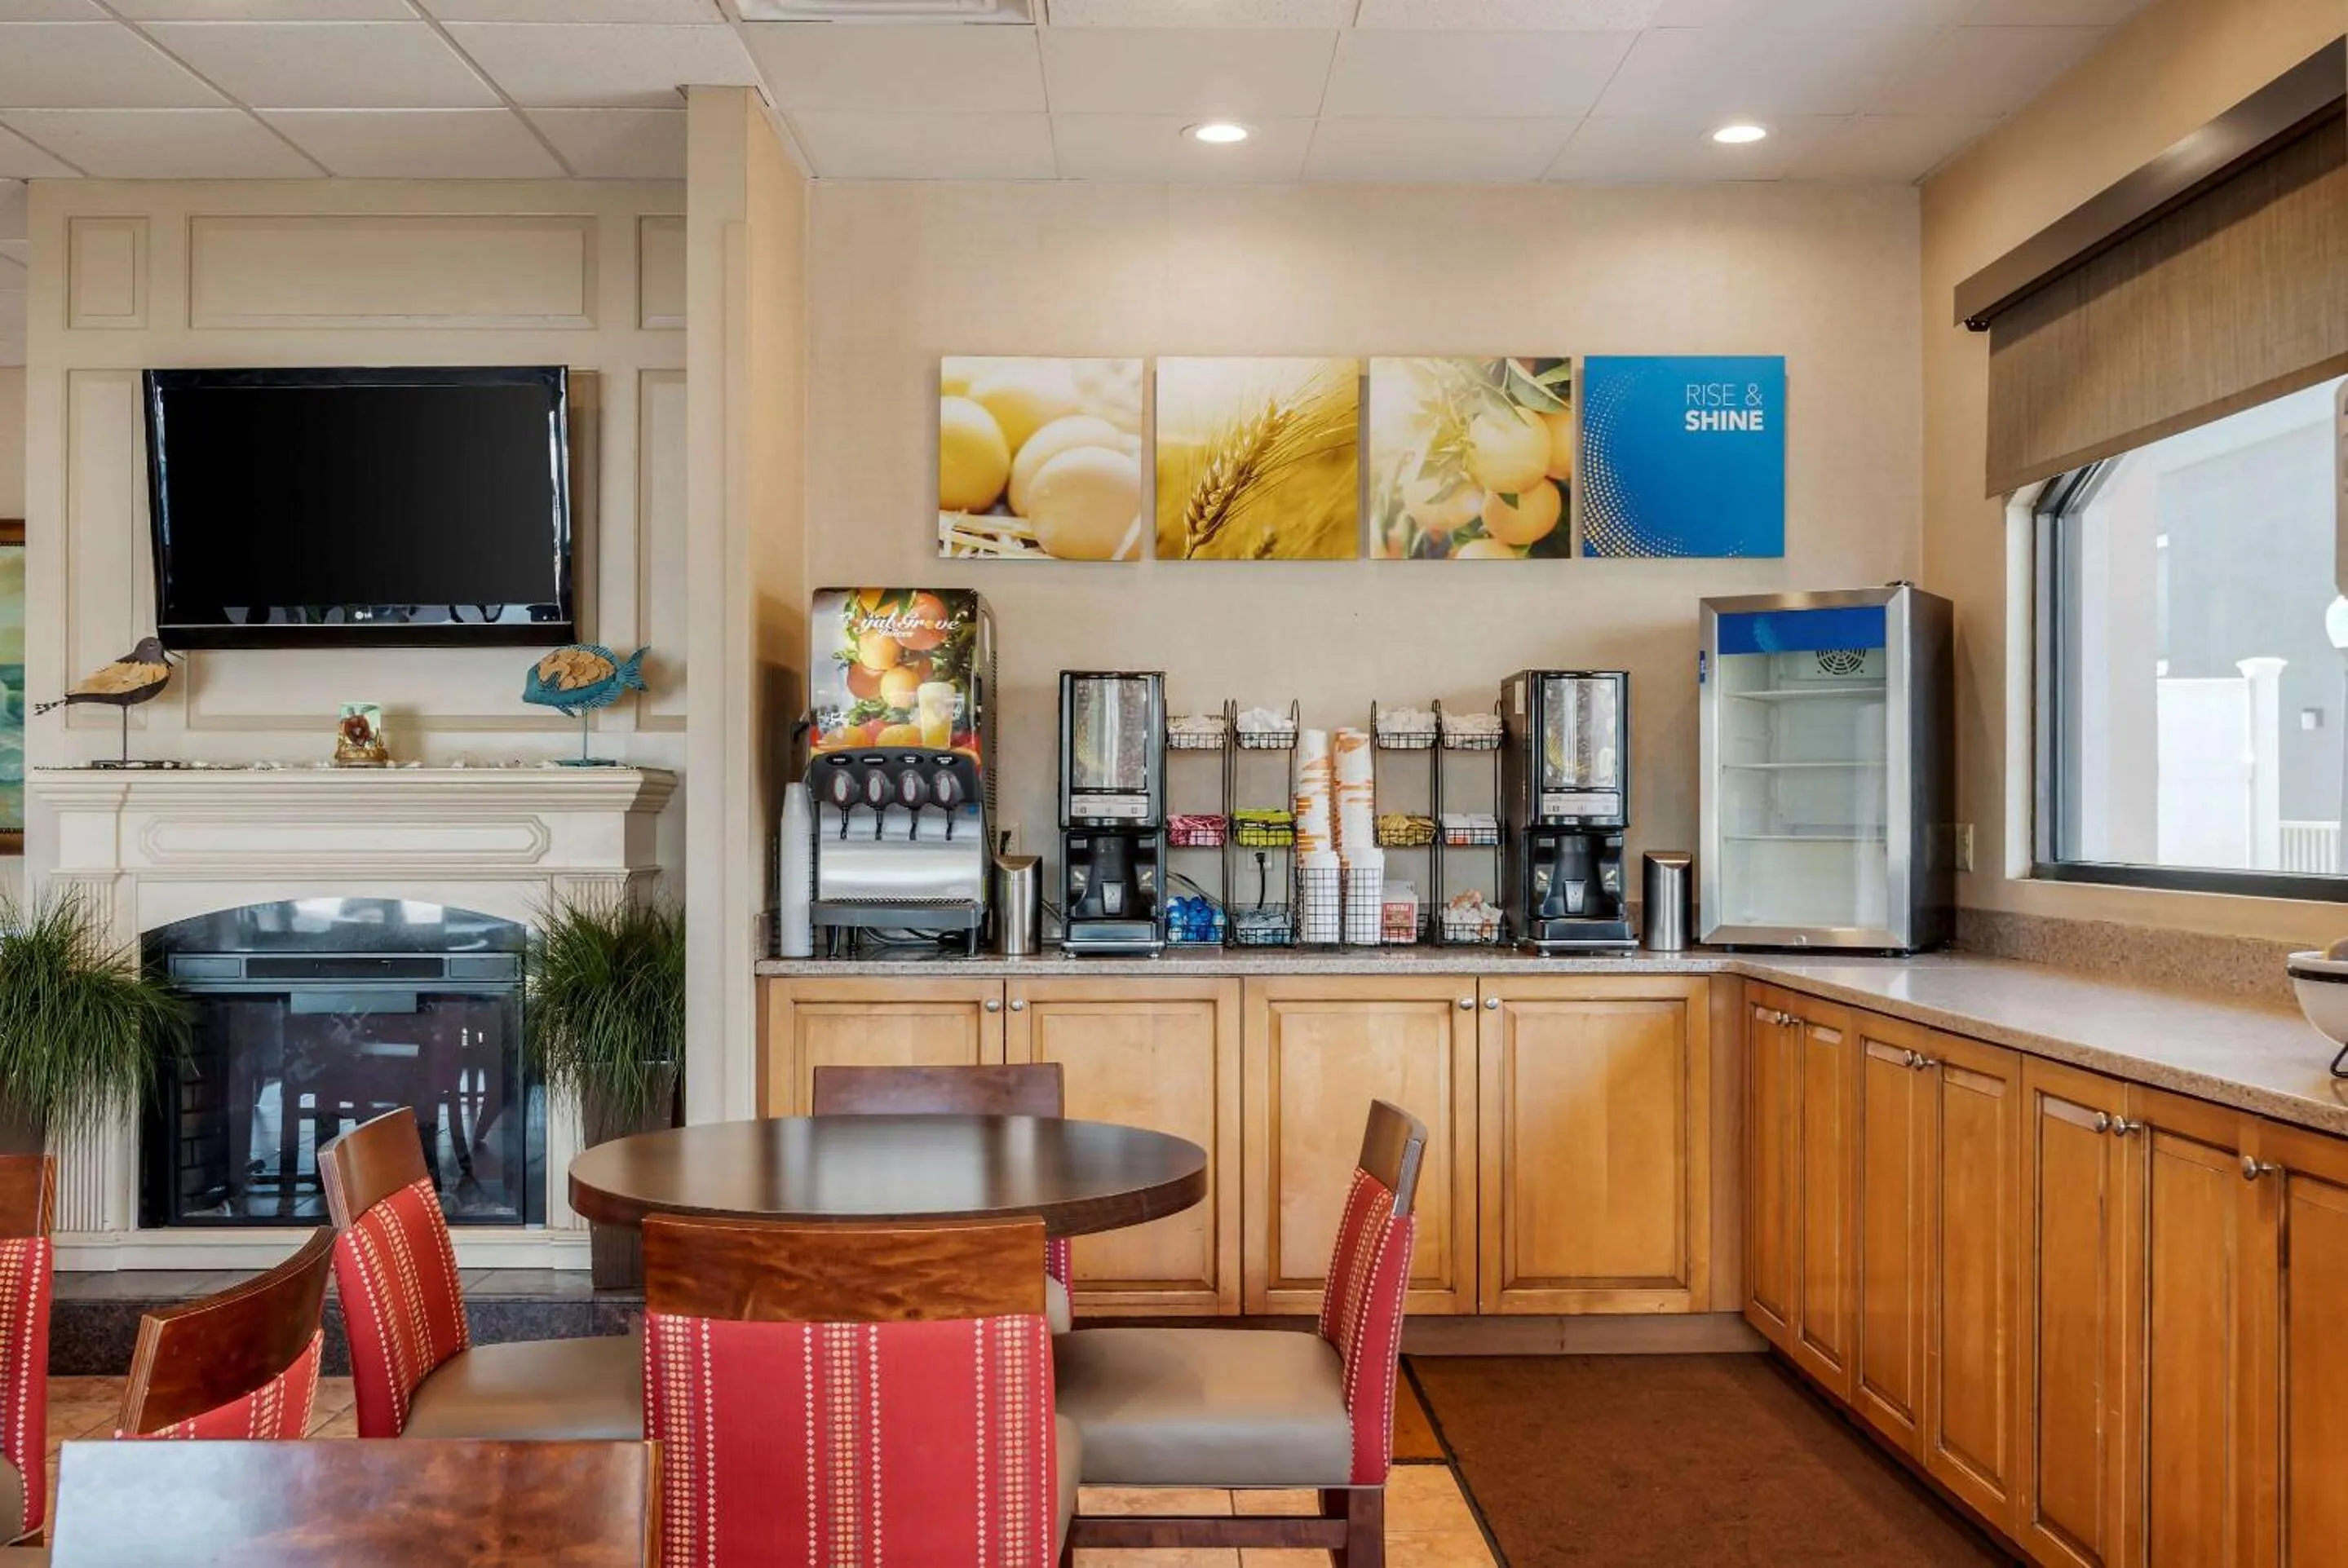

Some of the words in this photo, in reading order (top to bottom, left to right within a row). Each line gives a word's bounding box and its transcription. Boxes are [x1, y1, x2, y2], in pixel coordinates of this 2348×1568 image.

[1687, 384, 1736, 406] RISE
[1744, 383, 1763, 406] &
[1685, 410, 1764, 431] SHINE
